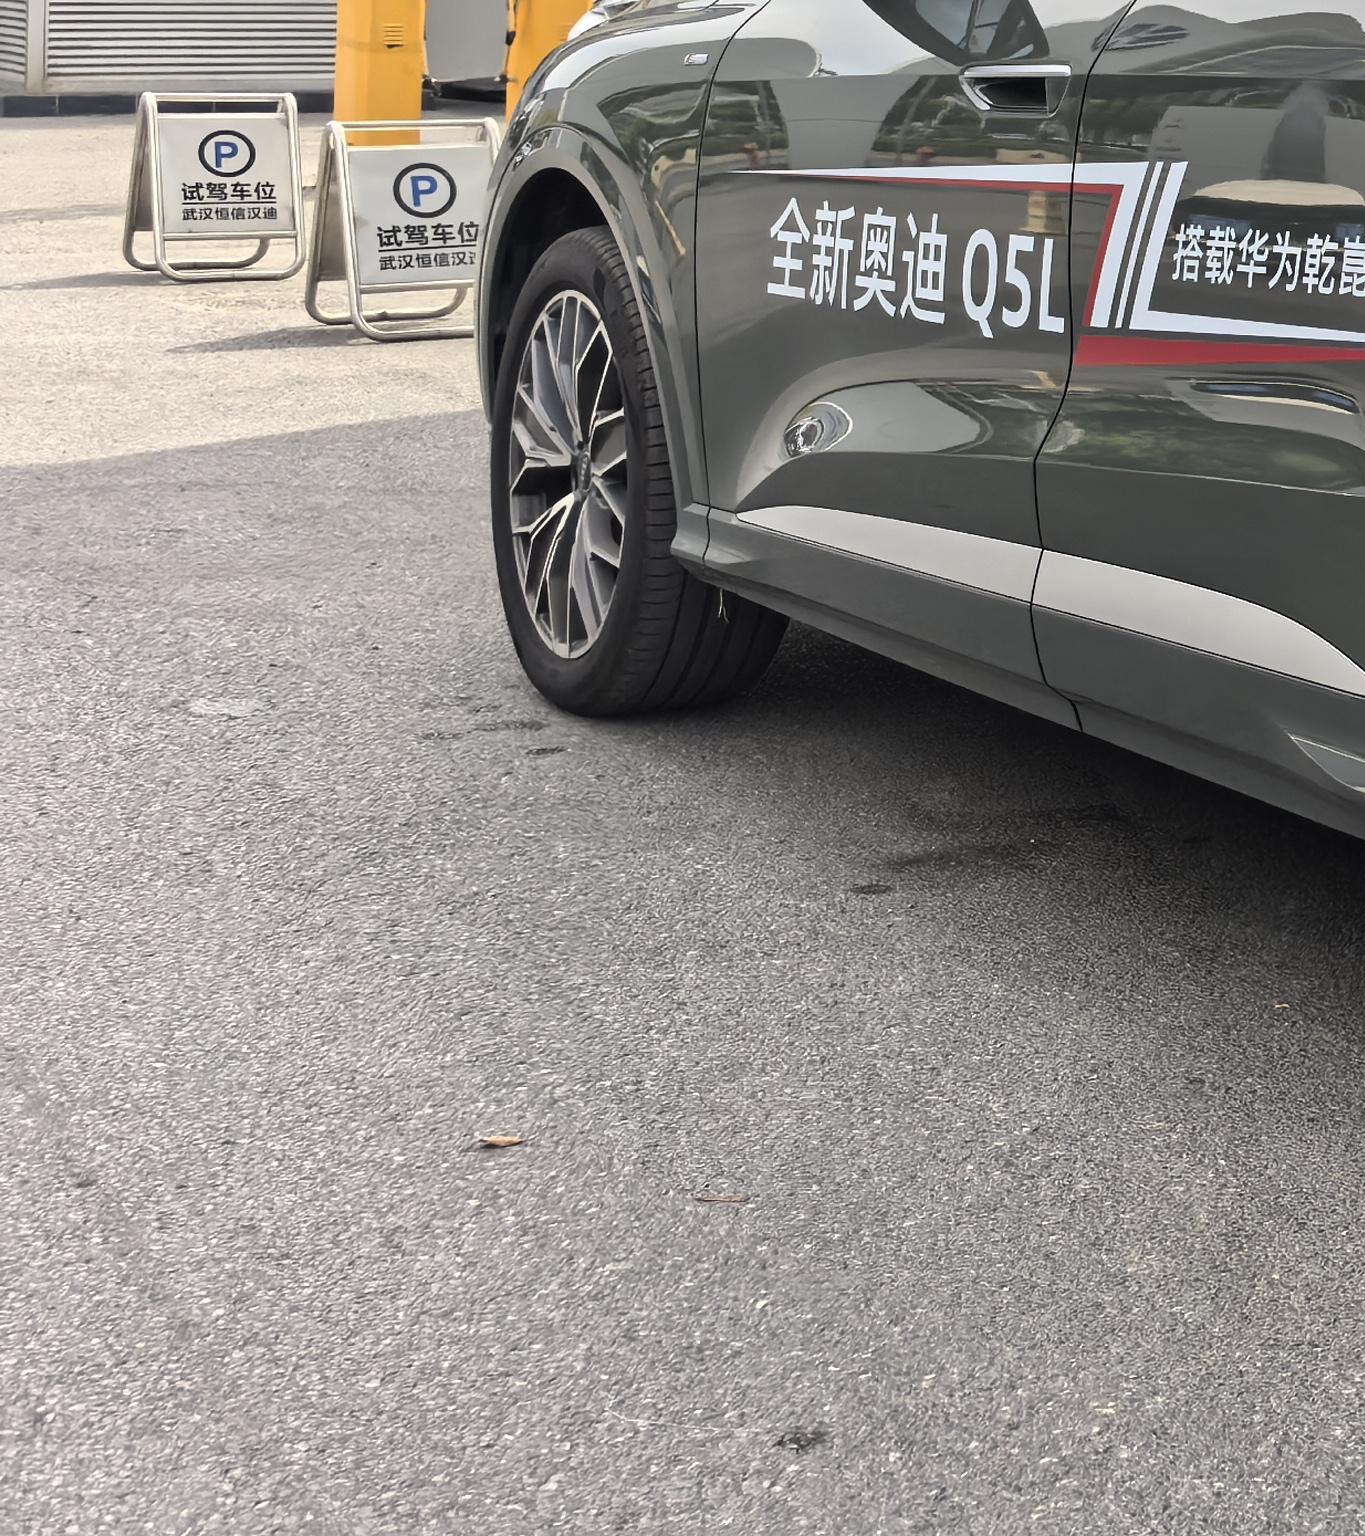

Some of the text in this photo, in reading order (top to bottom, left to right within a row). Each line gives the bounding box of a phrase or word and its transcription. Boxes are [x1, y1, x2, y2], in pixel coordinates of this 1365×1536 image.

[181, 181, 276, 201] 试驾车位
[182, 206, 277, 221] 武汉恒信汉迪
[377, 221, 479, 247] 试驾车位
[767, 197, 1065, 339] 全新奥迪 Q5L
